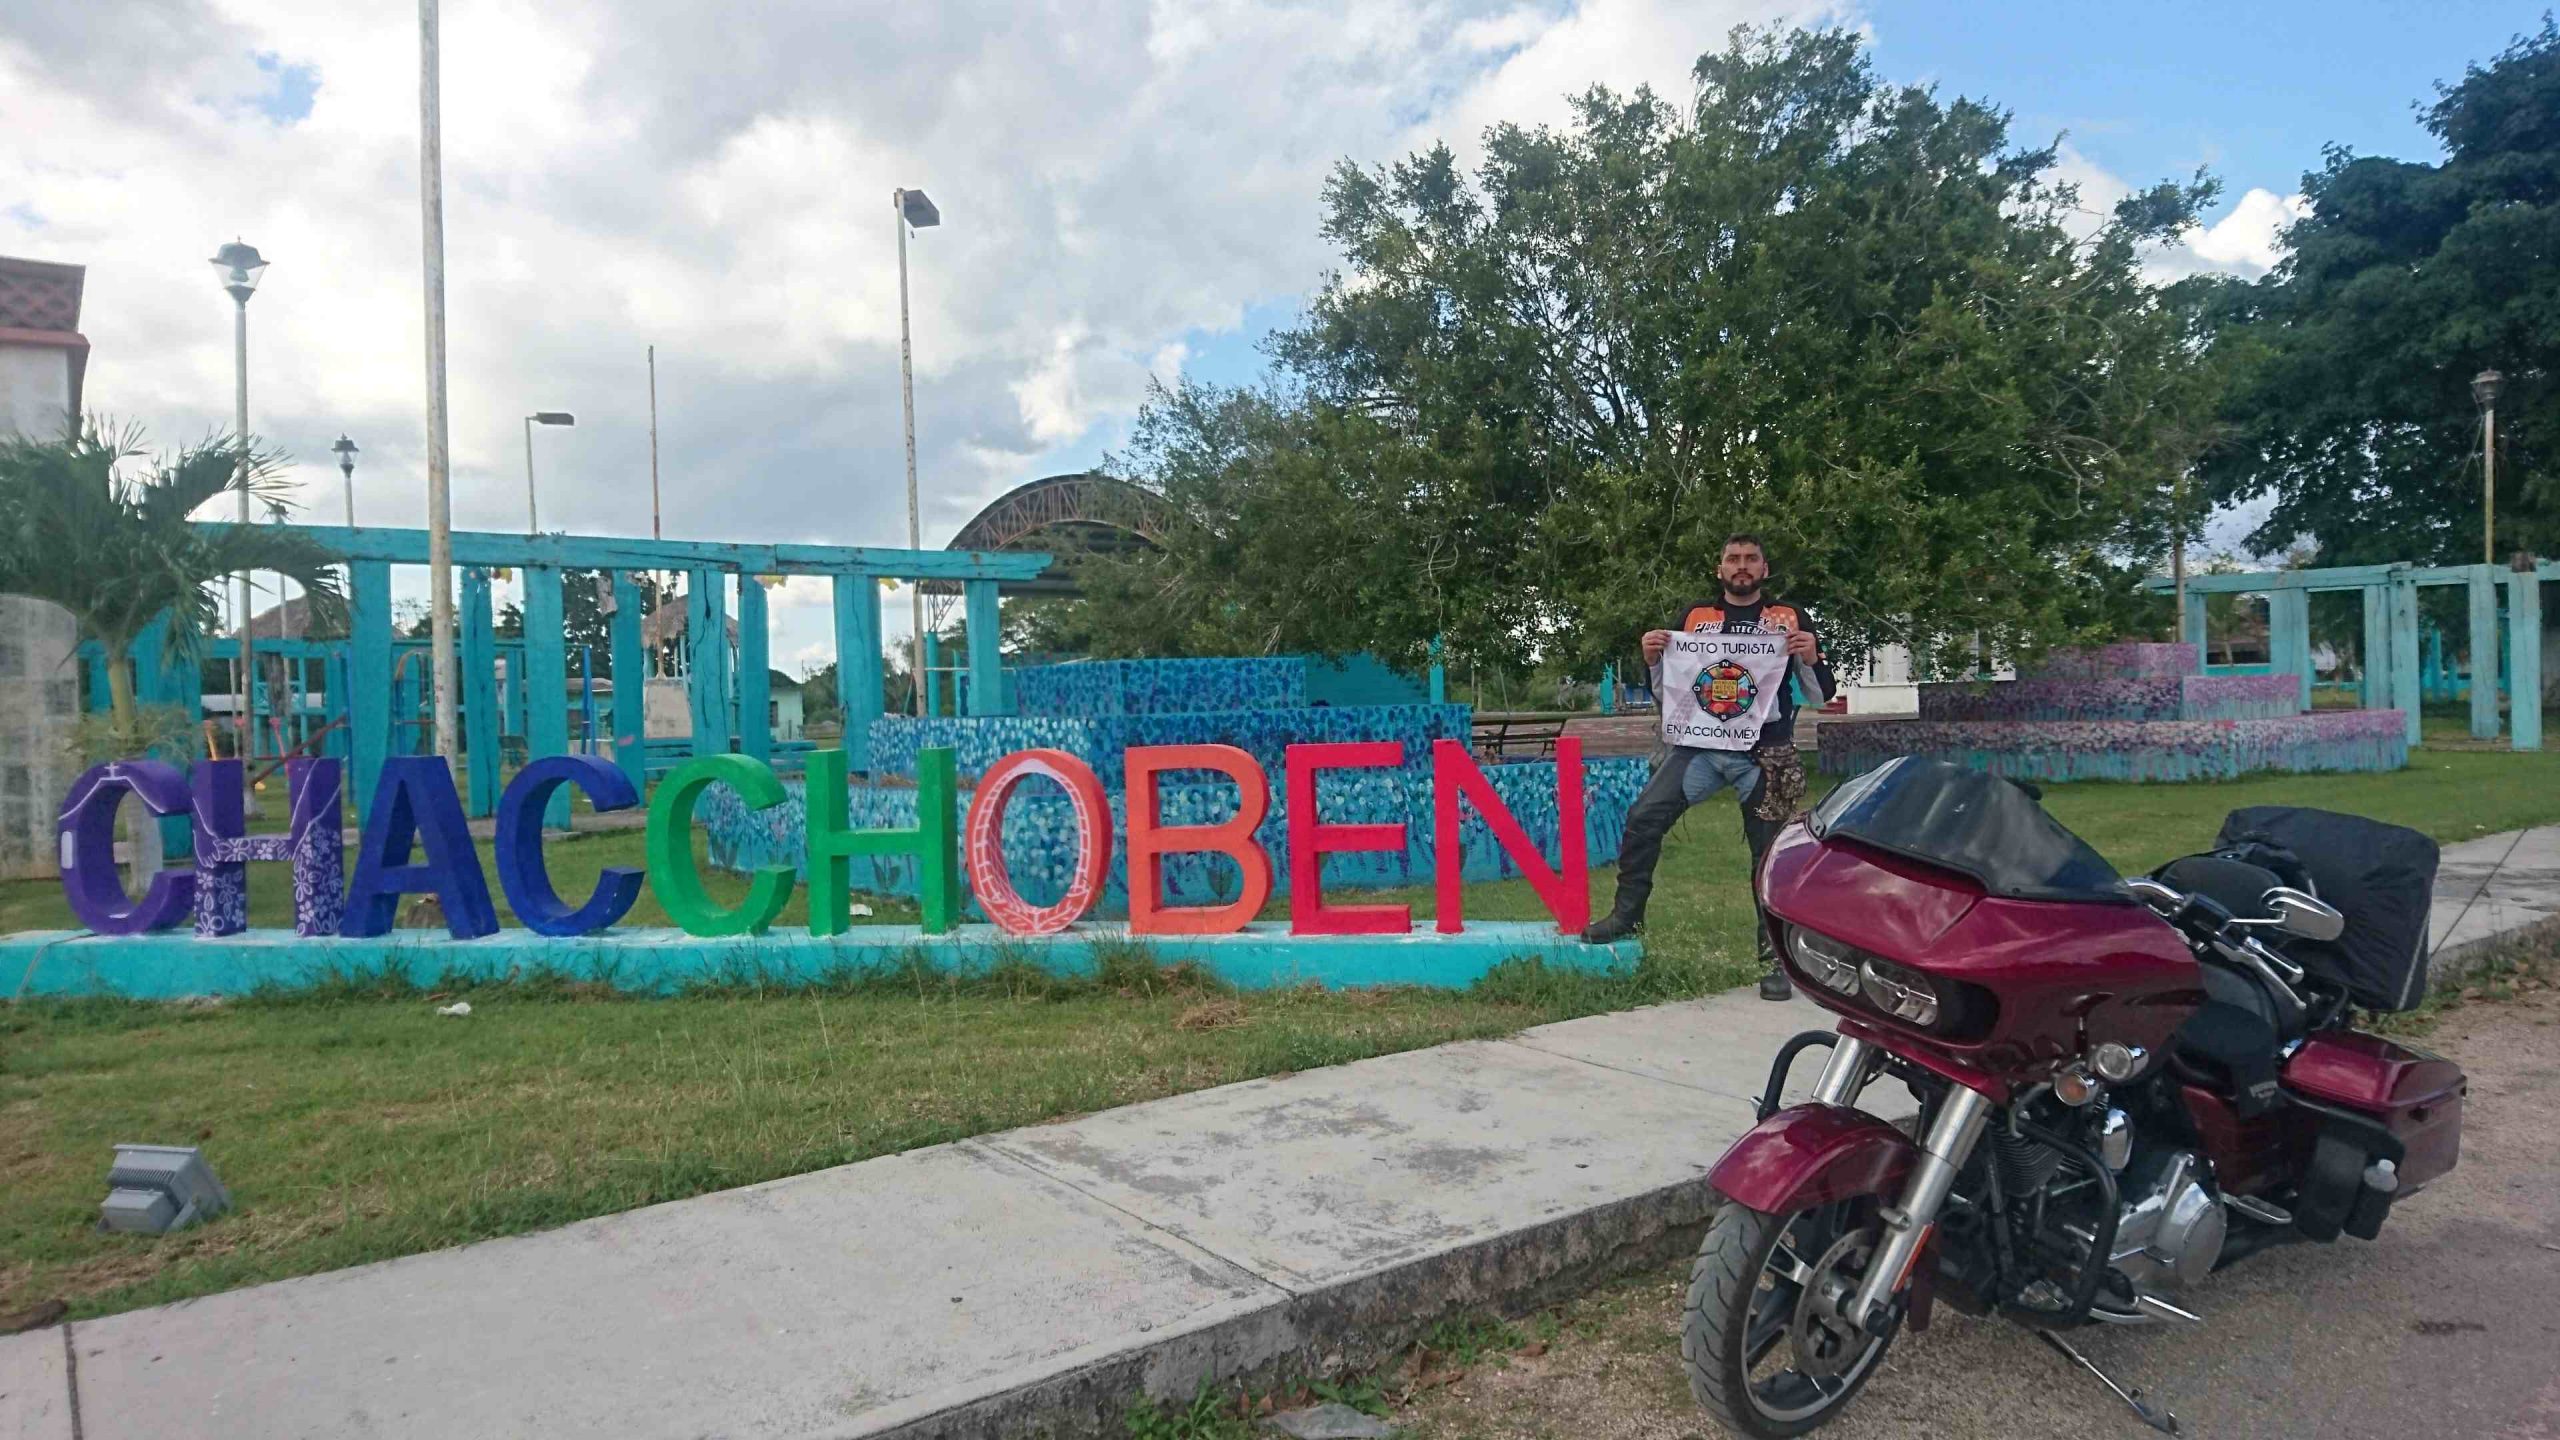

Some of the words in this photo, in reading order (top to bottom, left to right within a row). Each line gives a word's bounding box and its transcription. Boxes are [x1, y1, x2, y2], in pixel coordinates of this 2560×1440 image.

[1676, 641, 1718, 654] MOTO
[1722, 642, 1776, 655] TURISTA
[1666, 724, 1682, 735] EN
[1684, 725, 1731, 739] ACCIÓN
[58, 735, 1590, 940] CHACCHOBEN
